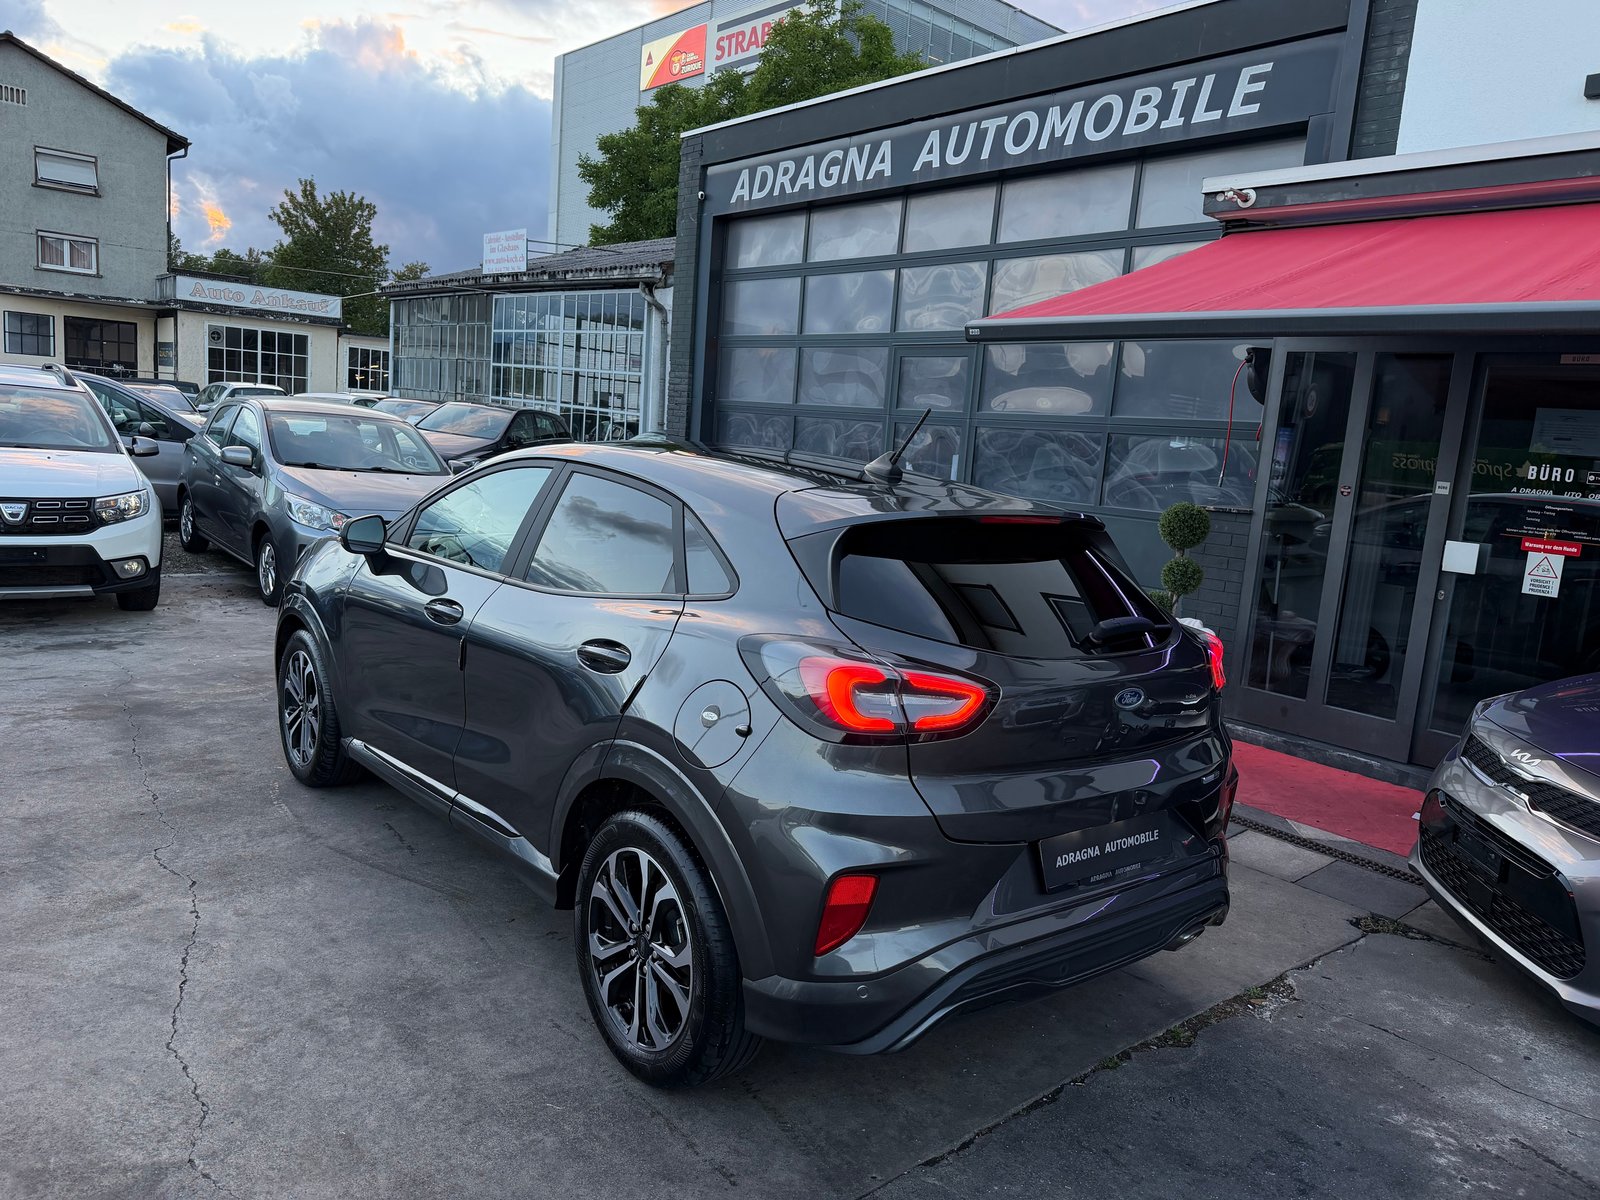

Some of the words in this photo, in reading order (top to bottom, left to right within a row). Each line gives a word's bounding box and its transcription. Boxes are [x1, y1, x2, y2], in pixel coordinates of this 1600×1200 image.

[714, 16, 786, 61] STRAB
[730, 140, 892, 203] ADRAGNA
[912, 61, 1275, 172] AUTOMOBILE
[189, 281, 245, 302] Auto
[250, 289, 330, 313] Ankauf
[1527, 464, 1575, 482] BÜRO
[1524, 542, 1545, 550] Warnung
[1121, 691, 1140, 705] Ford
[1055, 845, 1101, 868] ADRAGNA
[1104, 829, 1159, 854] AUTOMOBILE
